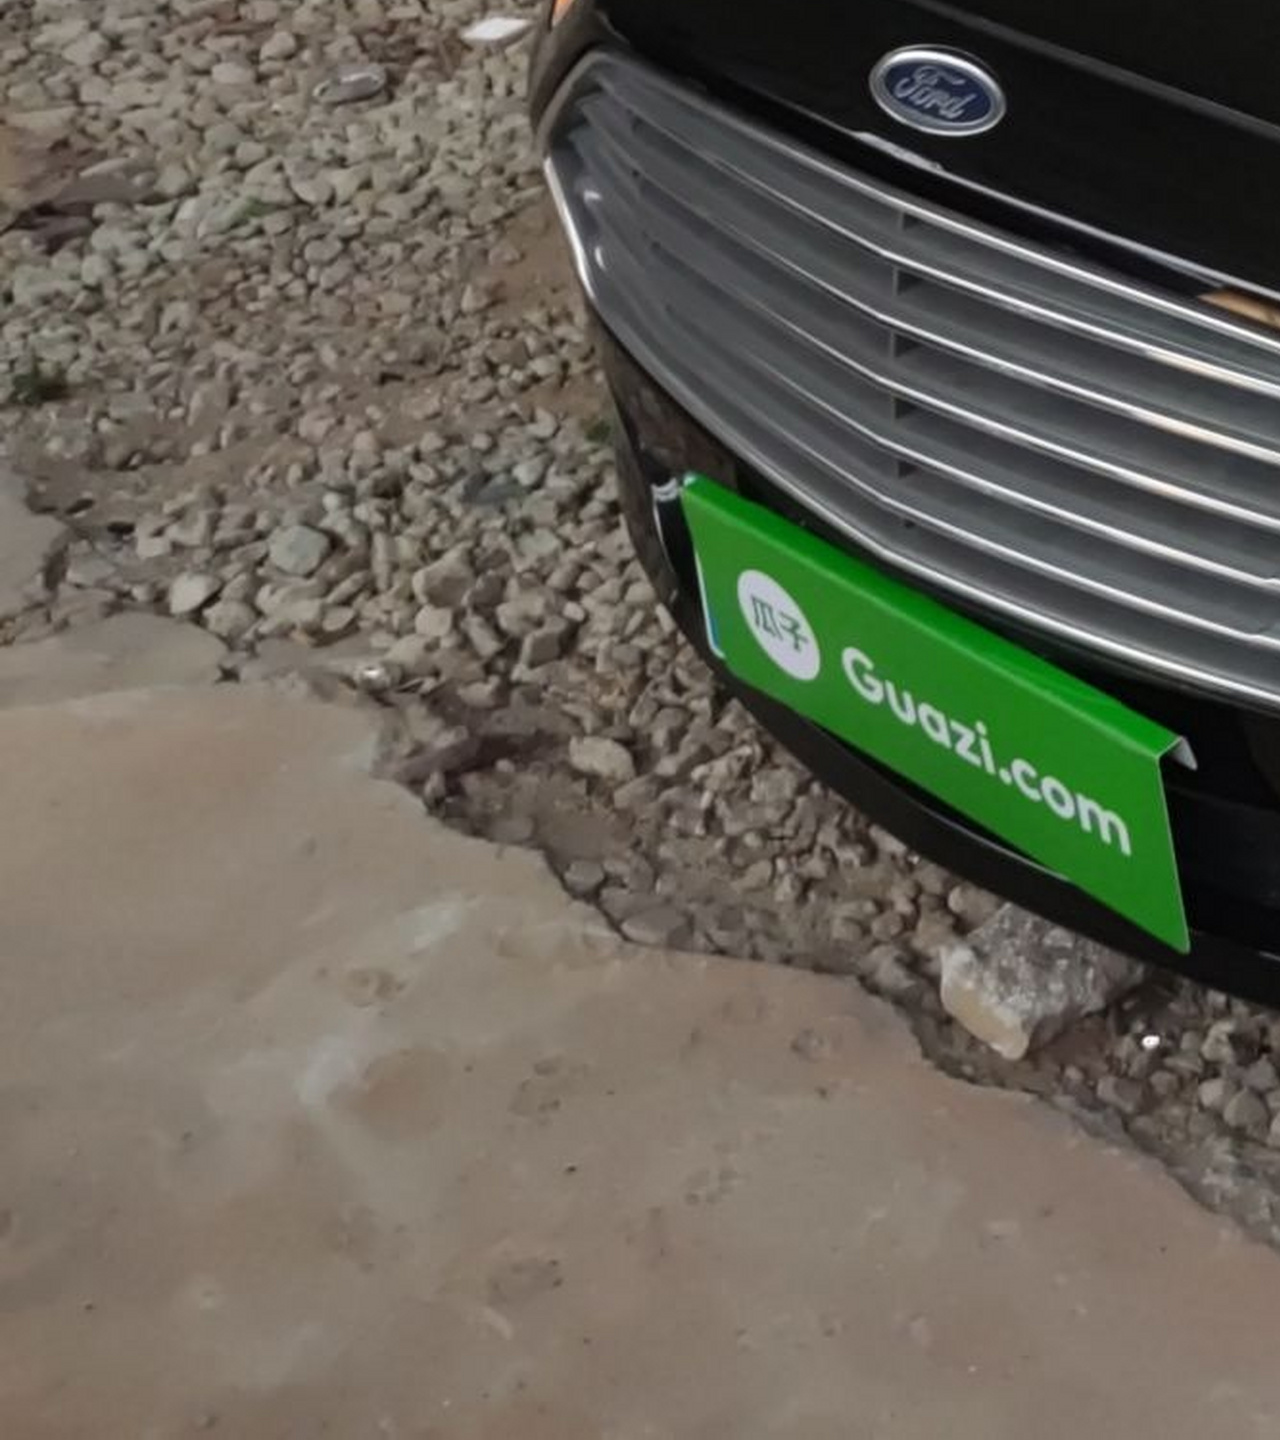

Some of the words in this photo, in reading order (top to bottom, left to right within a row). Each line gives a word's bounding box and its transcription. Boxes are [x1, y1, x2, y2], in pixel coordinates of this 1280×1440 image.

[894, 66, 976, 118] Ford
[751, 595, 808, 652] 瓜子
[841, 647, 1131, 855] Guazi.com
